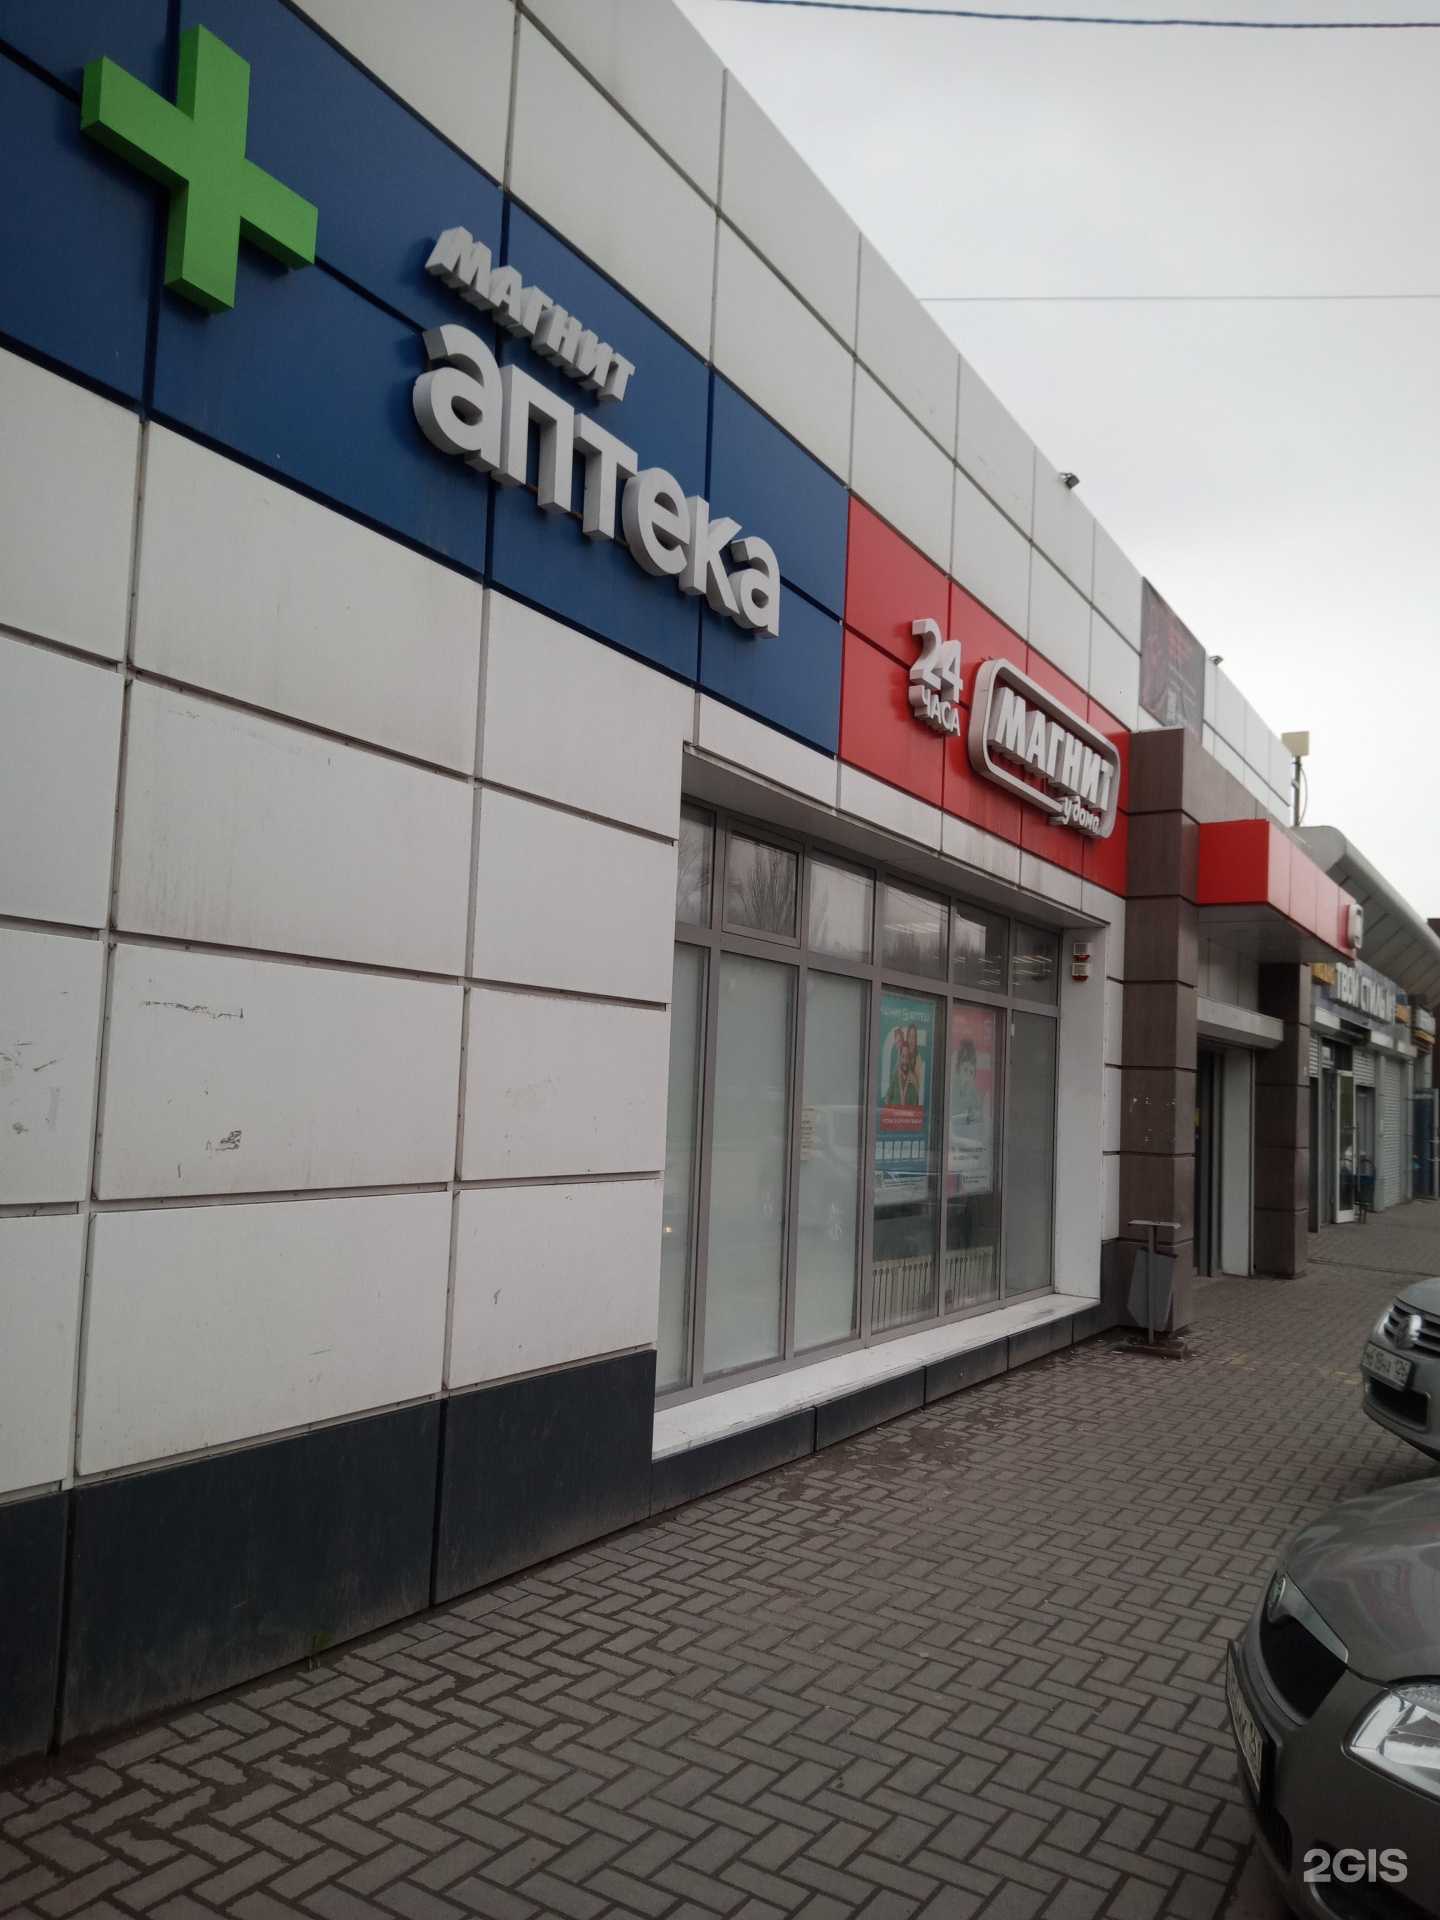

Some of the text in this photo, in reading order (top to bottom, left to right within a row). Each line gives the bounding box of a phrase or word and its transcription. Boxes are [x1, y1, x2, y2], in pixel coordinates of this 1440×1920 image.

[426, 226, 636, 401] МАГНИТ
[413, 324, 780, 638] аптека
[909, 685, 960, 736] ЧАСА
[910, 618, 963, 703] 24
[990, 687, 1114, 812] МАГНИТ
